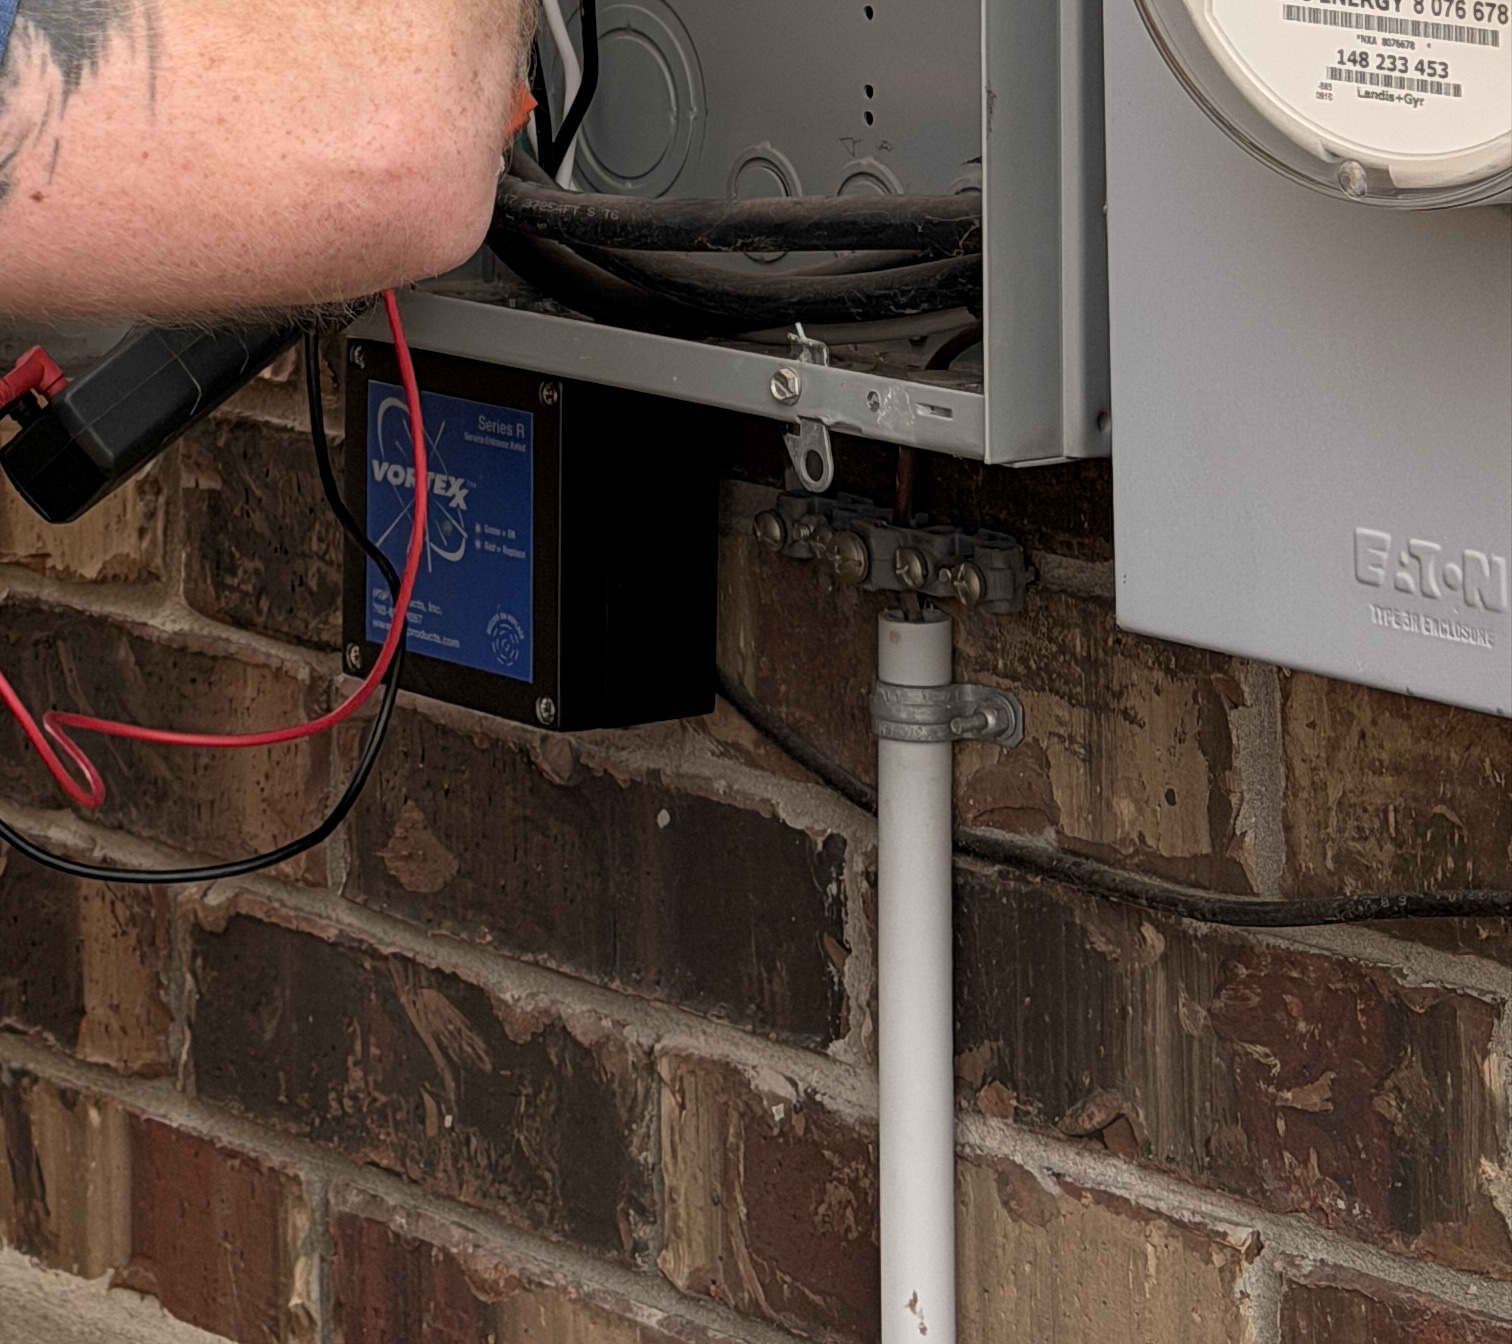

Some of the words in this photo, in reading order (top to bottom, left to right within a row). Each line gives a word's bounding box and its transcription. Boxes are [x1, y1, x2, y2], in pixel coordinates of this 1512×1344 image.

[1473, 0, 1510, 25] 678
[1336, 49, 1370, 69] 148
[1375, 52, 1409, 74] 233
[1414, 58, 1449, 80] 453
[1356, 85, 1425, 109] Landis+Gyr
[477, 414, 513, 437] Series
[515, 422, 526, 440] R
